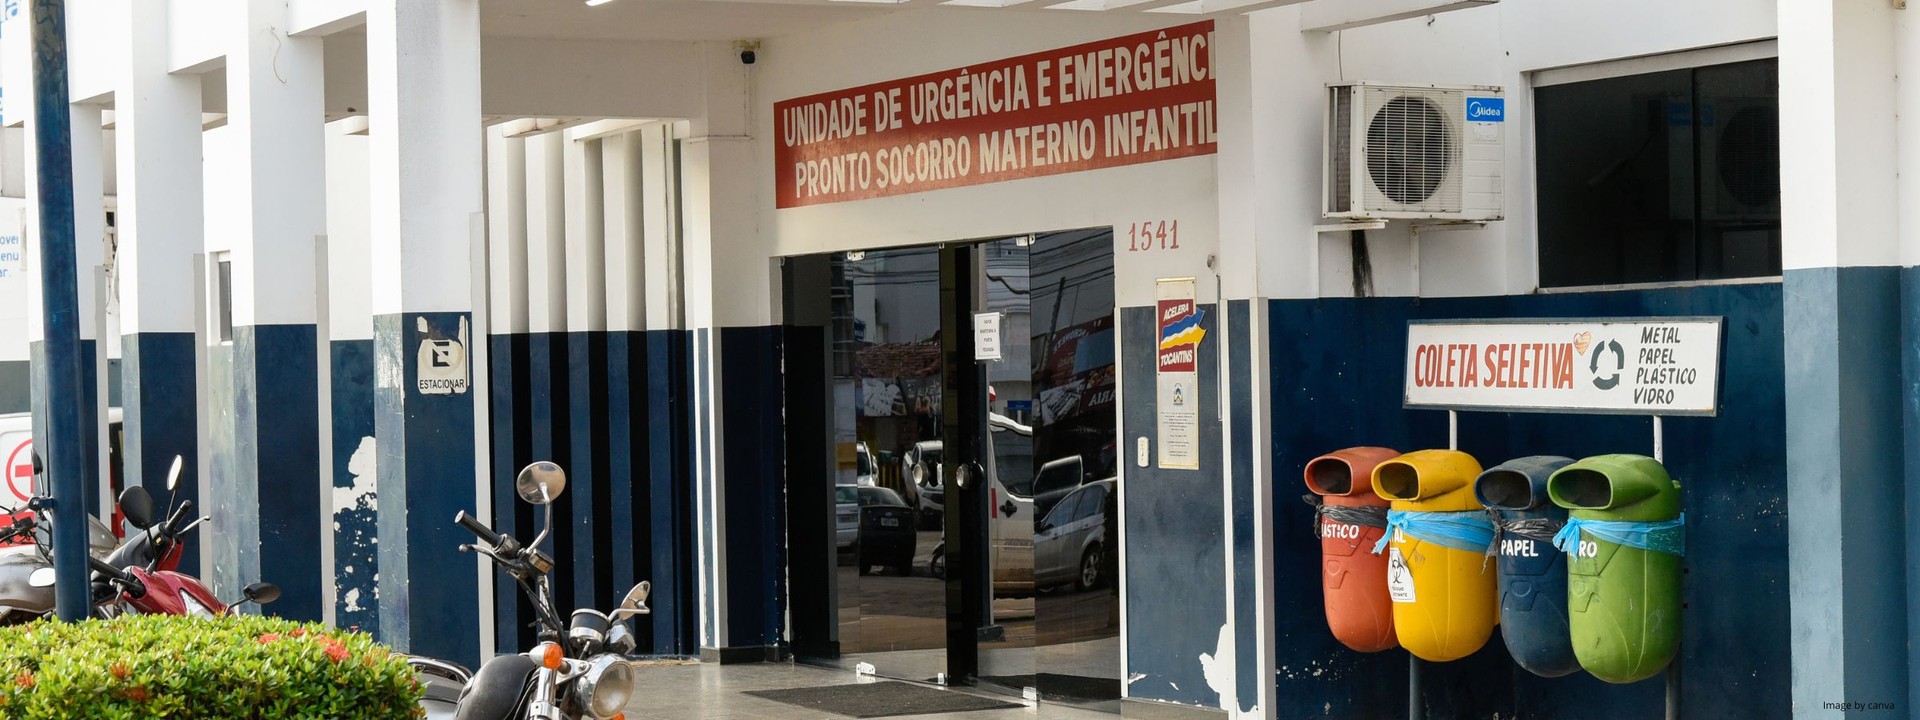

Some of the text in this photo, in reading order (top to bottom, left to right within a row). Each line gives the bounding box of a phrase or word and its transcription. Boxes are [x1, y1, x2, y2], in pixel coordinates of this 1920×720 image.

[783, 94, 867, 147] UNIDADE
[874, 88, 902, 133] DE
[909, 64, 1030, 125] URGÊNCIA
[1037, 60, 1051, 107] E
[1470, 101, 1501, 117] Midea
[795, 100, 1217, 199] PRONTO SOCORRO MATERNO INFANTIL
[1128, 219, 1180, 252] 1541
[1163, 303, 1190, 321] ACELERA
[1640, 326, 1681, 345] METAL
[1160, 349, 1193, 367] TOCANTINS
[1638, 347, 1677, 365] PAPEL
[1415, 342, 1574, 390] COLETA SELETIVA
[1636, 363, 1697, 386] PLÁSTICO
[419, 378, 465, 389] ESTACIONAR
[1633, 386, 1675, 405] VIDRO
[1500, 539, 1539, 557] PAPEL
